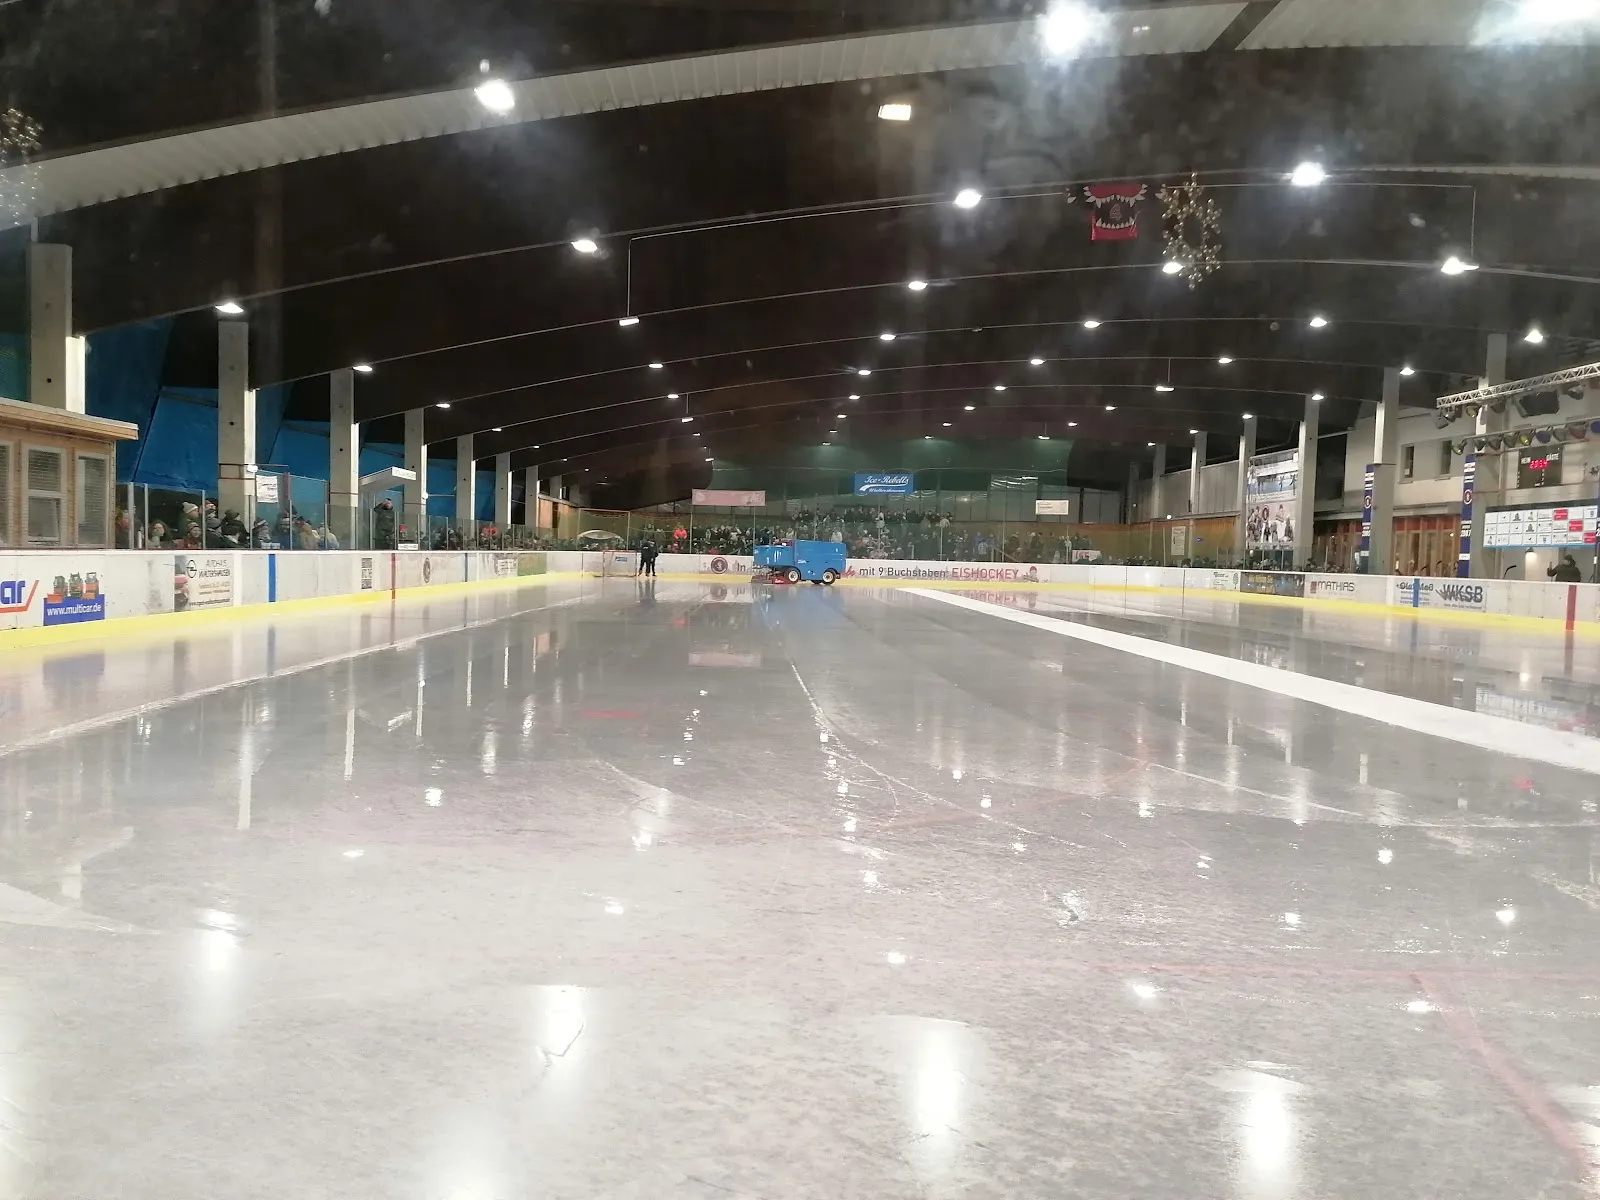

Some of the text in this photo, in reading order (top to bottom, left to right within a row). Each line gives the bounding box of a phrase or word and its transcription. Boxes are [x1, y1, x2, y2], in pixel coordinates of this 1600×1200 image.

[859, 566, 875, 576] mit
[878, 566, 885, 576] 9
[951, 567, 1019, 579] EISHOCKEY
[1317, 580, 1355, 592] MATHIAS
[1443, 583, 1484, 604] WKSB
[46, 602, 102, 616] www.multicar.de
